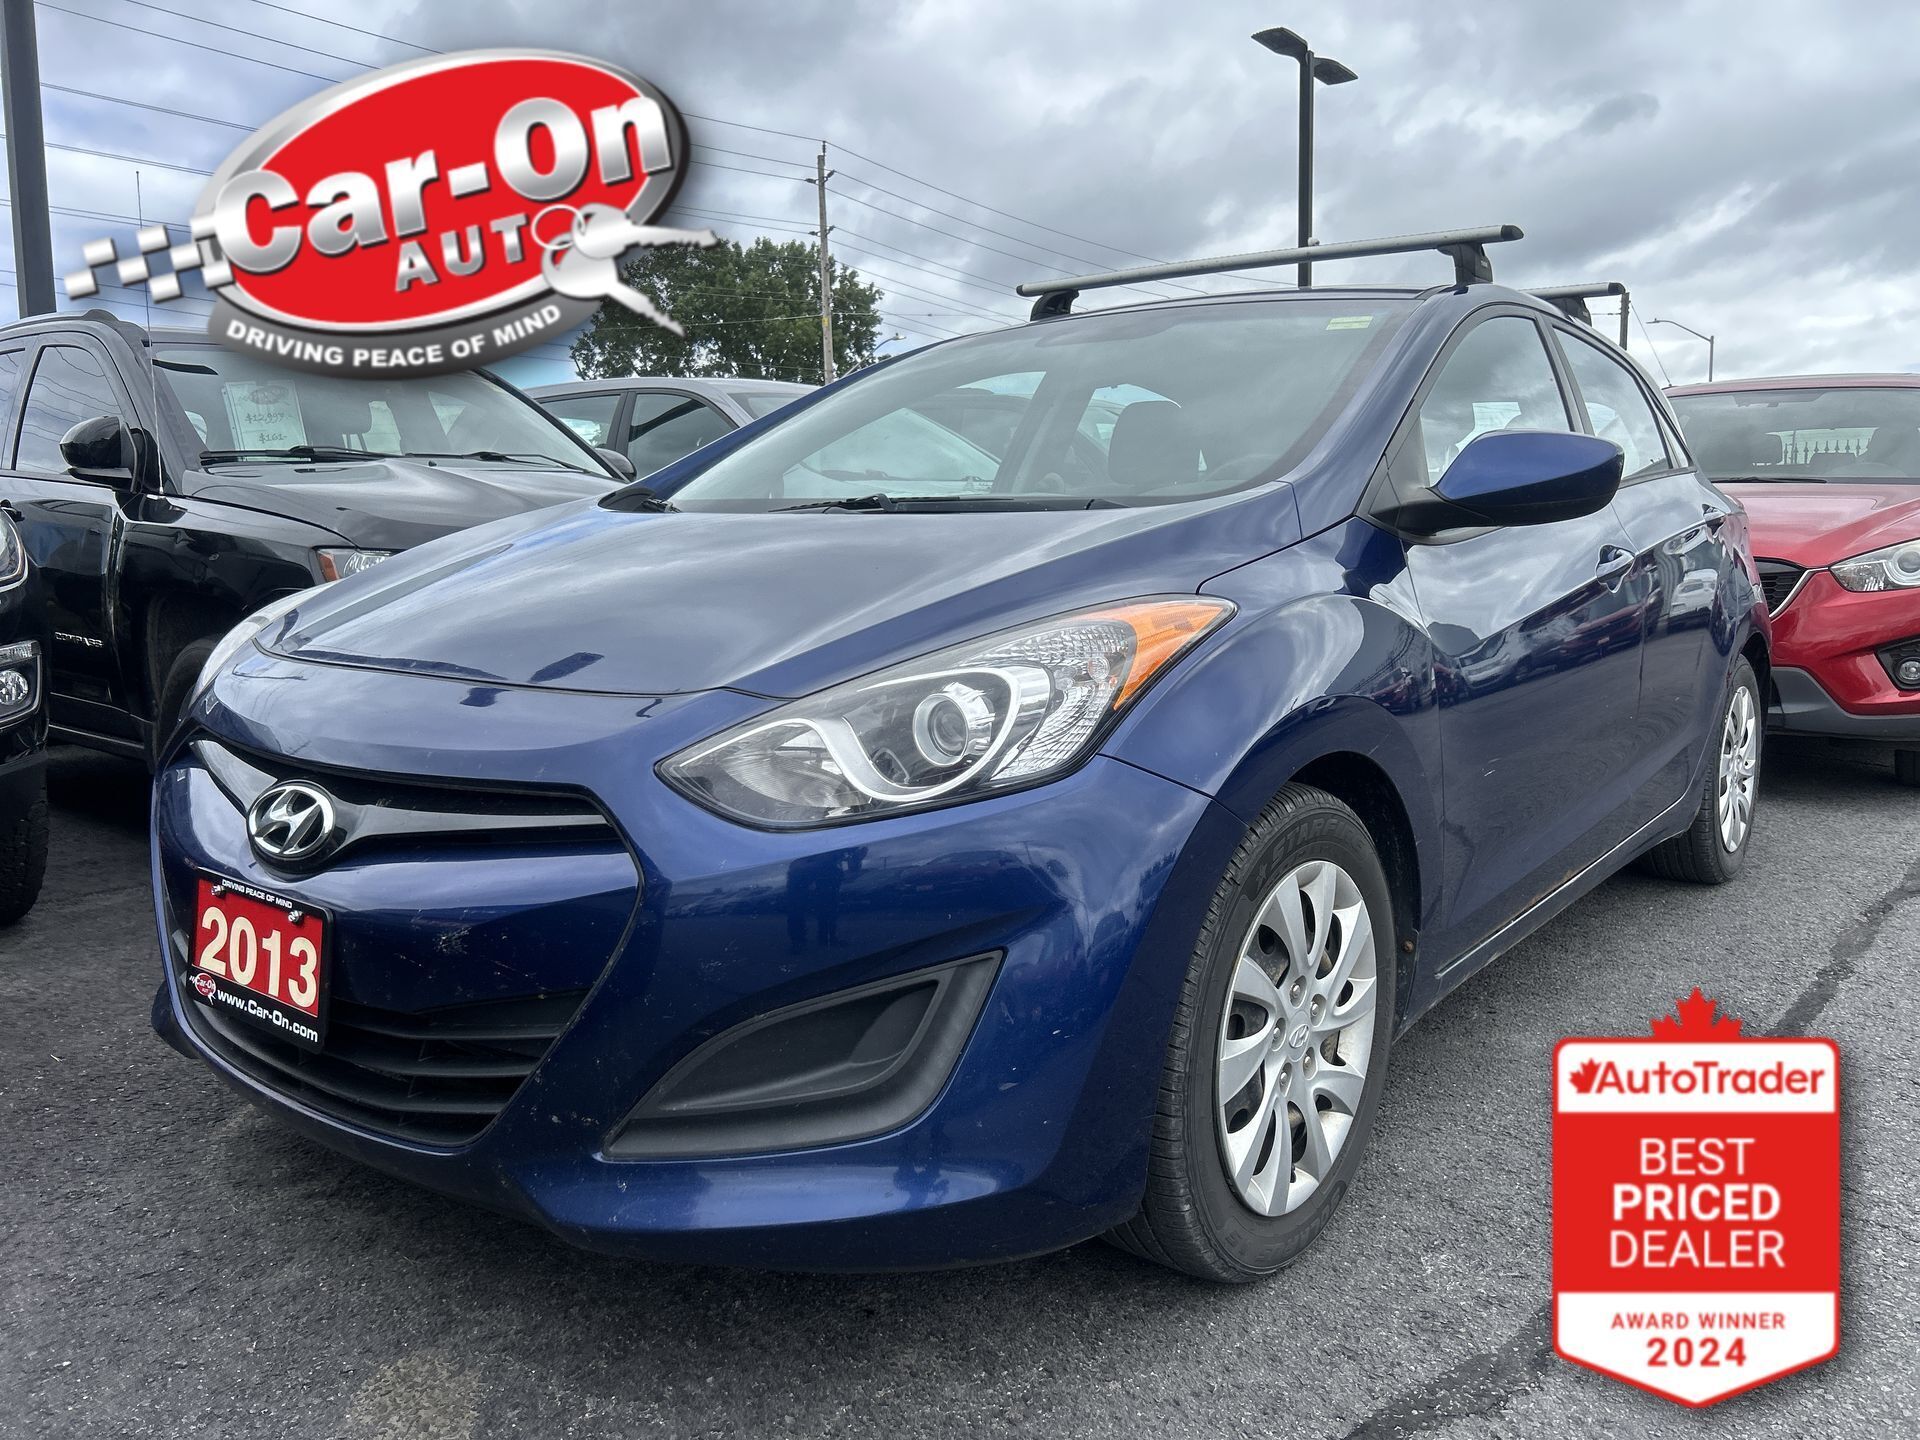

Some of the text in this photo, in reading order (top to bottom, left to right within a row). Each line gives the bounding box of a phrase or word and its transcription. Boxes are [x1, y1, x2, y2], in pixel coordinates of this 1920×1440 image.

[222, 879, 293, 909] DRIVING PEACE OF MIND
[199, 906, 317, 1008] 2013
[217, 989, 318, 1042] www.Car-On.com
